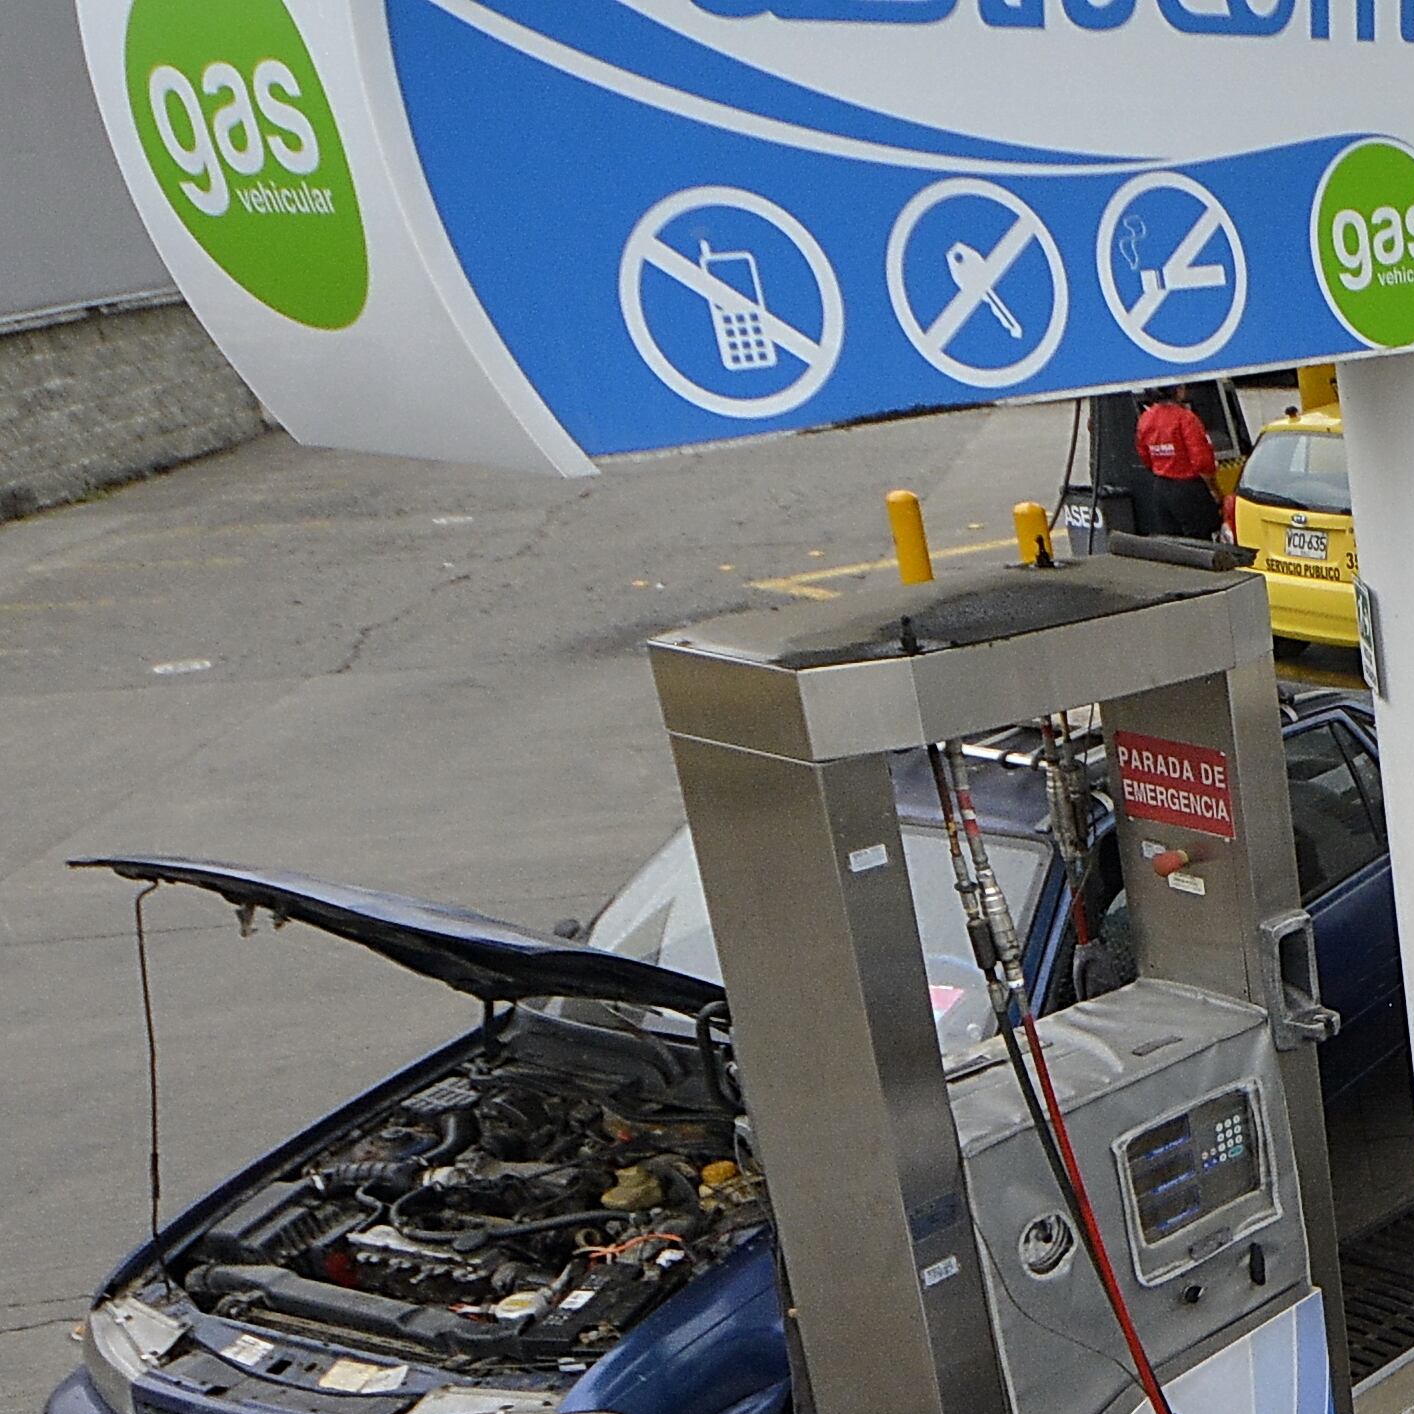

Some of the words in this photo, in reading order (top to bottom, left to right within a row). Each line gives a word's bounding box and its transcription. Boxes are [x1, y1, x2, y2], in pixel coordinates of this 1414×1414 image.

[149, 59, 320, 217] gas
[236, 181, 336, 215] vehicular
[1064, 504, 1103, 529] ASEO
[1265, 558, 1303, 577] SERVICIO
[1304, 563, 1341, 582] PUBLICO
[1118, 745, 1195, 783] PARADA
[1200, 763, 1226, 789] DE
[1122, 778, 1230, 822] EMERGENCIA
